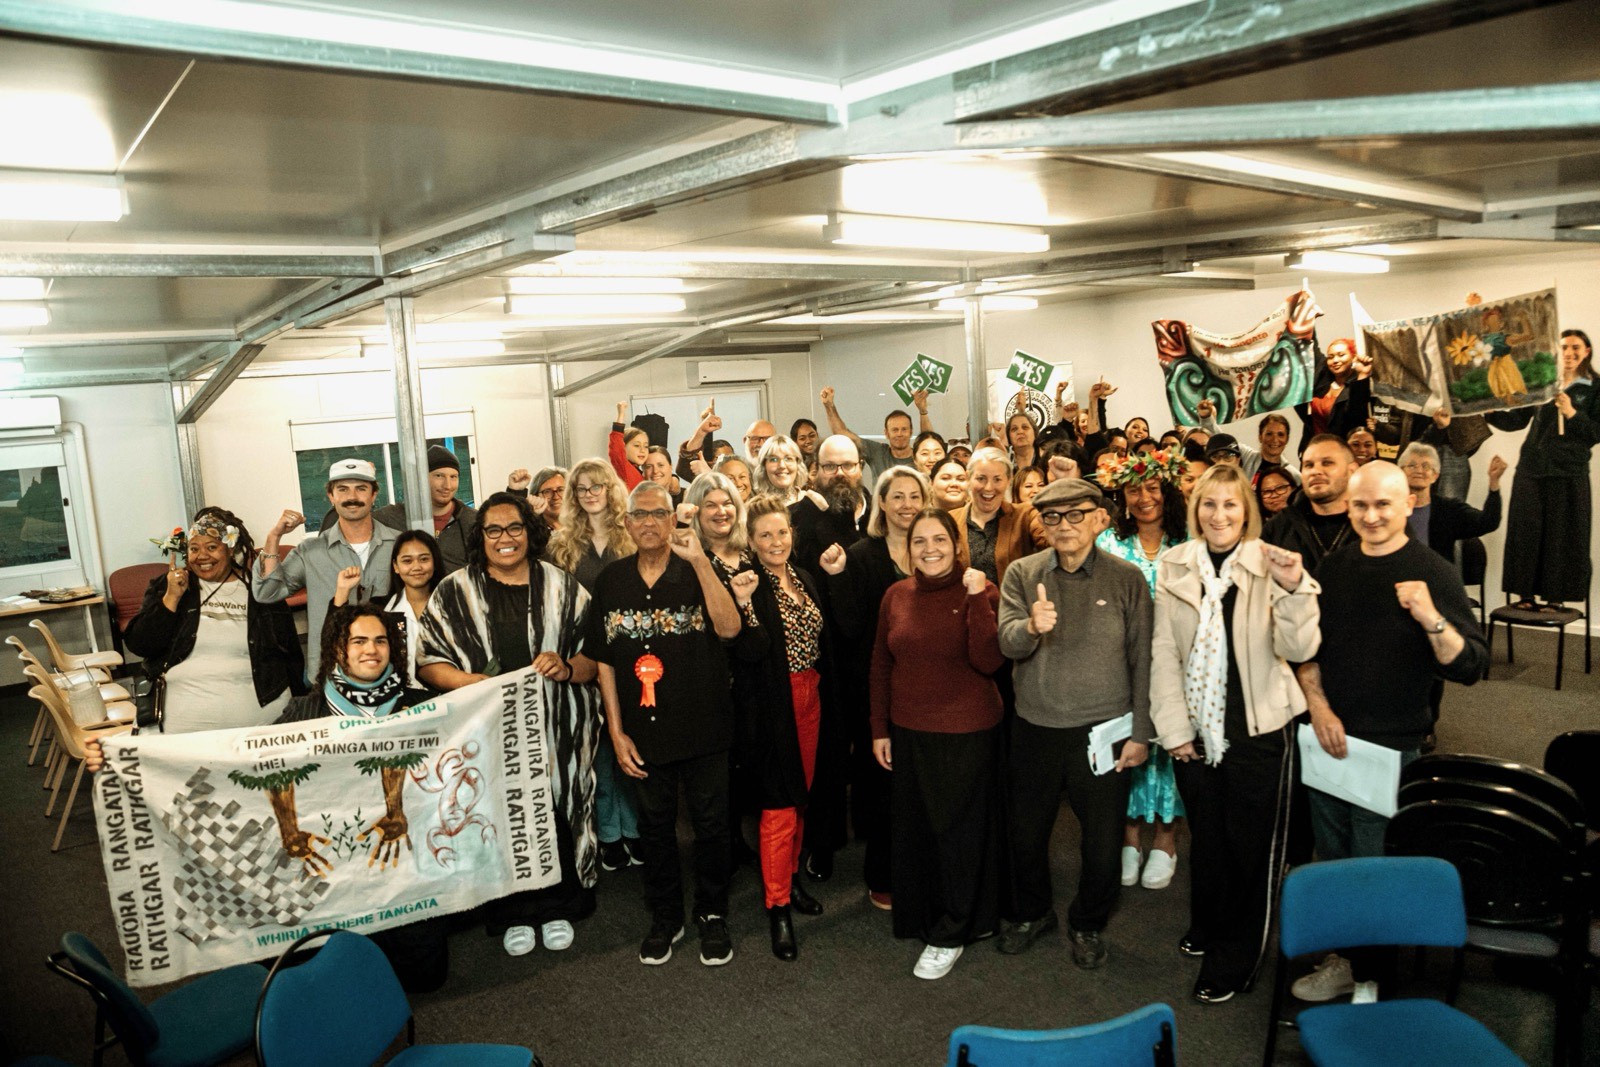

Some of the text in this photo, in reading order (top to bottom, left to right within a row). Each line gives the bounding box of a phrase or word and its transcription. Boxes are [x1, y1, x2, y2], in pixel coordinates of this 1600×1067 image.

[898, 368, 926, 398] YES
[244, 732, 307, 750] TIAKINA
[310, 728, 330, 740] TE
[406, 702, 437, 717] TIPU
[313, 736, 440, 756] PAINGA MO TE IWI
[501, 682, 532, 880] RATHGAR RATHGAR
[523, 672, 554, 877] RANGATIRA RARANGA
[118, 746, 171, 971] RATHGAR RATHGAR
[117, 890, 144, 970] RAUORA
[256, 927, 309, 948] WHIRIA
[335, 913, 374, 930] HERE
[376, 897, 439, 922] TANGATA
